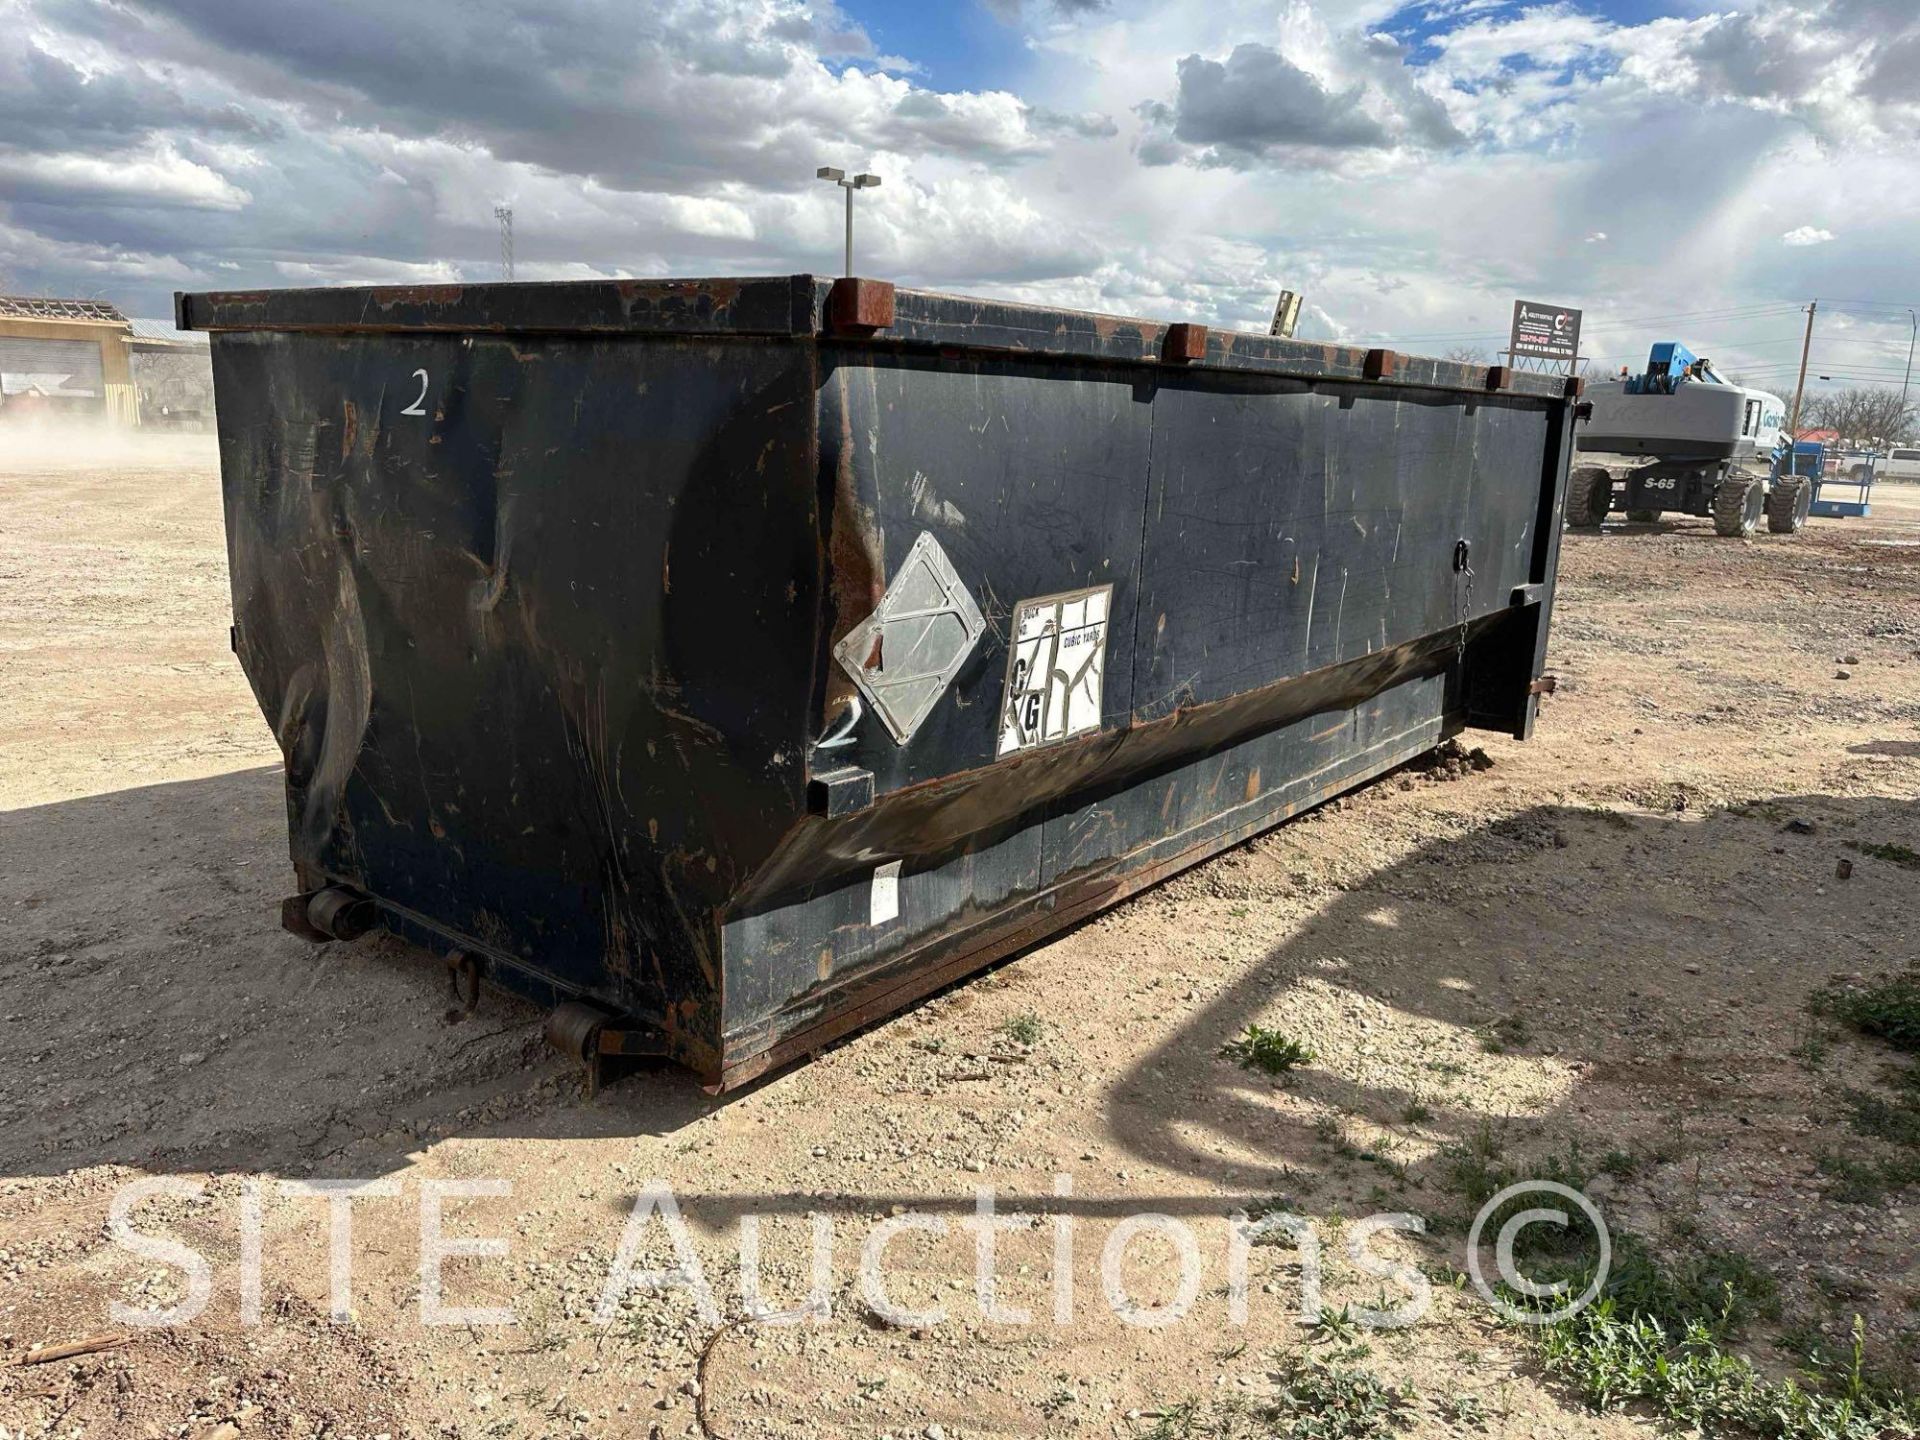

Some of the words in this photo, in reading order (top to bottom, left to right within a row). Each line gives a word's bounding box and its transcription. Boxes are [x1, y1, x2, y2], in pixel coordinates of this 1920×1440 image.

[400, 368, 429, 416] 2
[1644, 477, 1676, 489] S-65
[1063, 634, 1081, 649] CUBIC
[1083, 630, 1101, 644] YARDS
[1025, 693, 1040, 731] G
